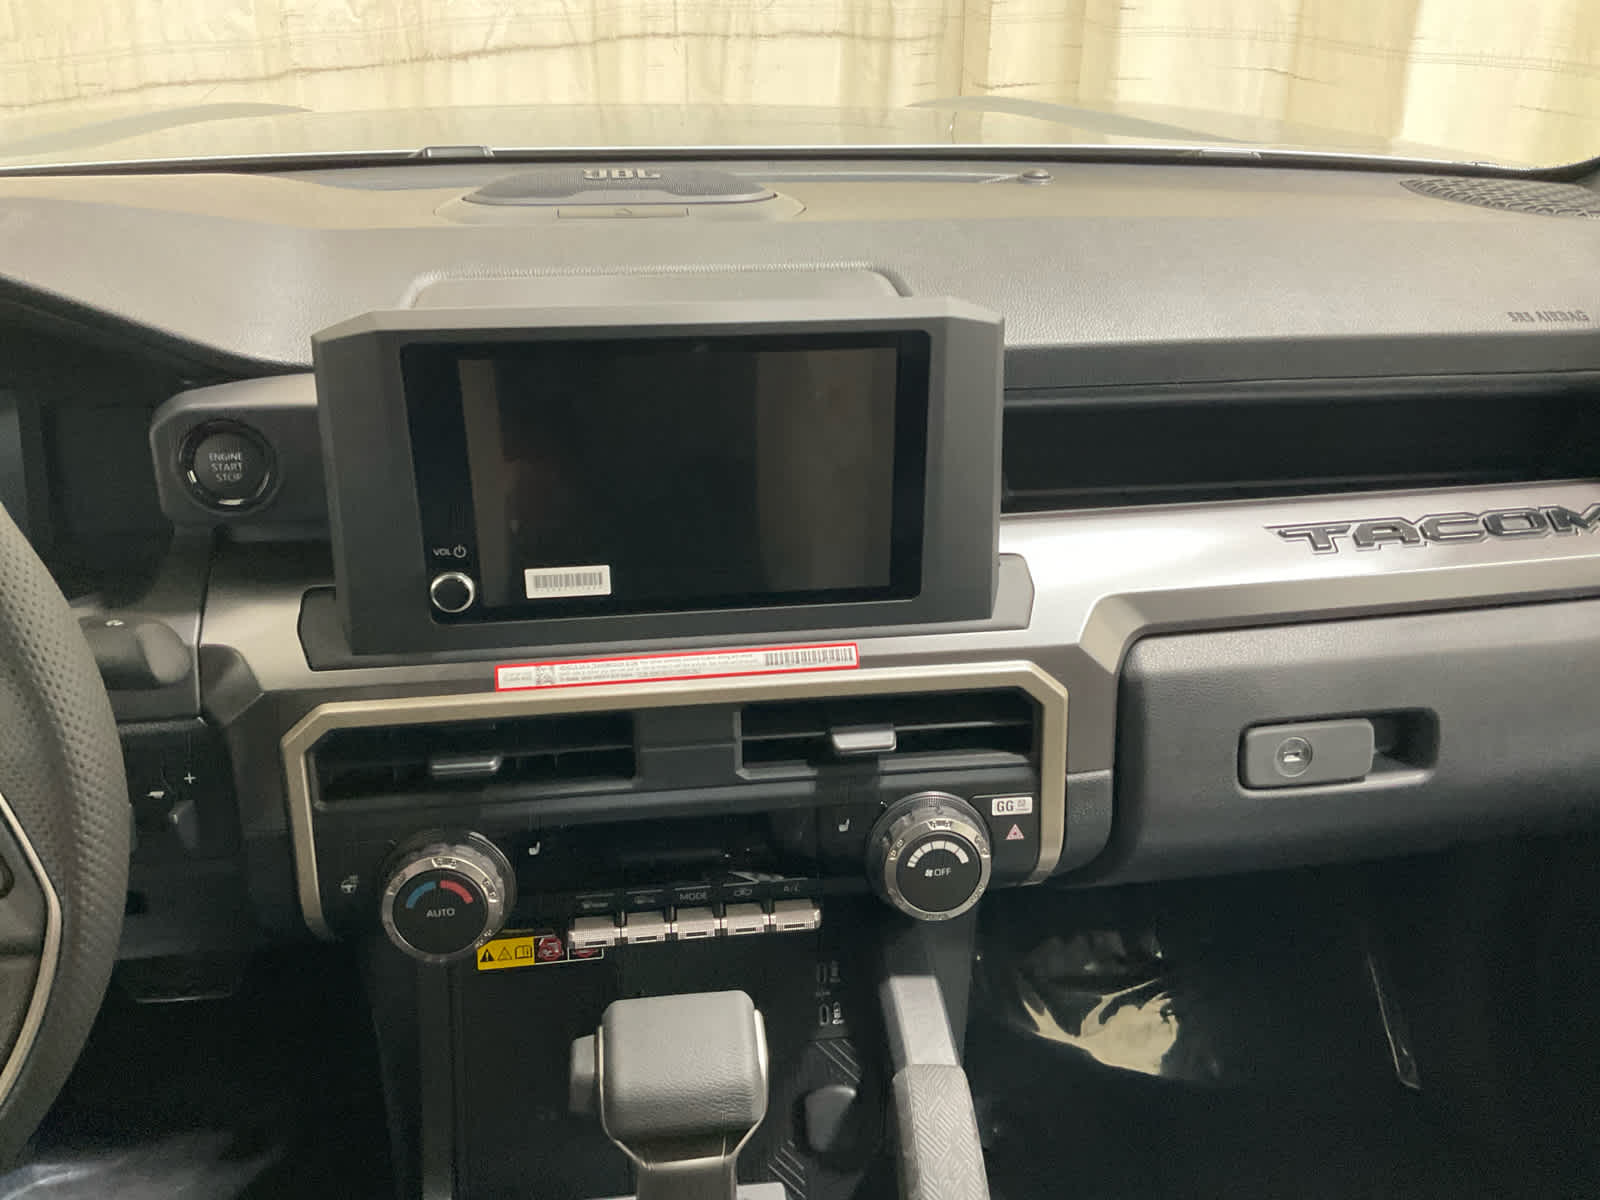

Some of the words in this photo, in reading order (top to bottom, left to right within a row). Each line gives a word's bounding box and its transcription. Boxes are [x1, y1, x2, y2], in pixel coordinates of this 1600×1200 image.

[208, 452, 243, 461] ENGINE
[211, 462, 243, 472] START
[215, 472, 243, 482] STOP
[433, 548, 451, 557] VOL
[996, 800, 1014, 812] GG
[934, 868, 951, 877] OFF
[679, 891, 708, 901] MODE
[426, 907, 456, 918] AUTO
